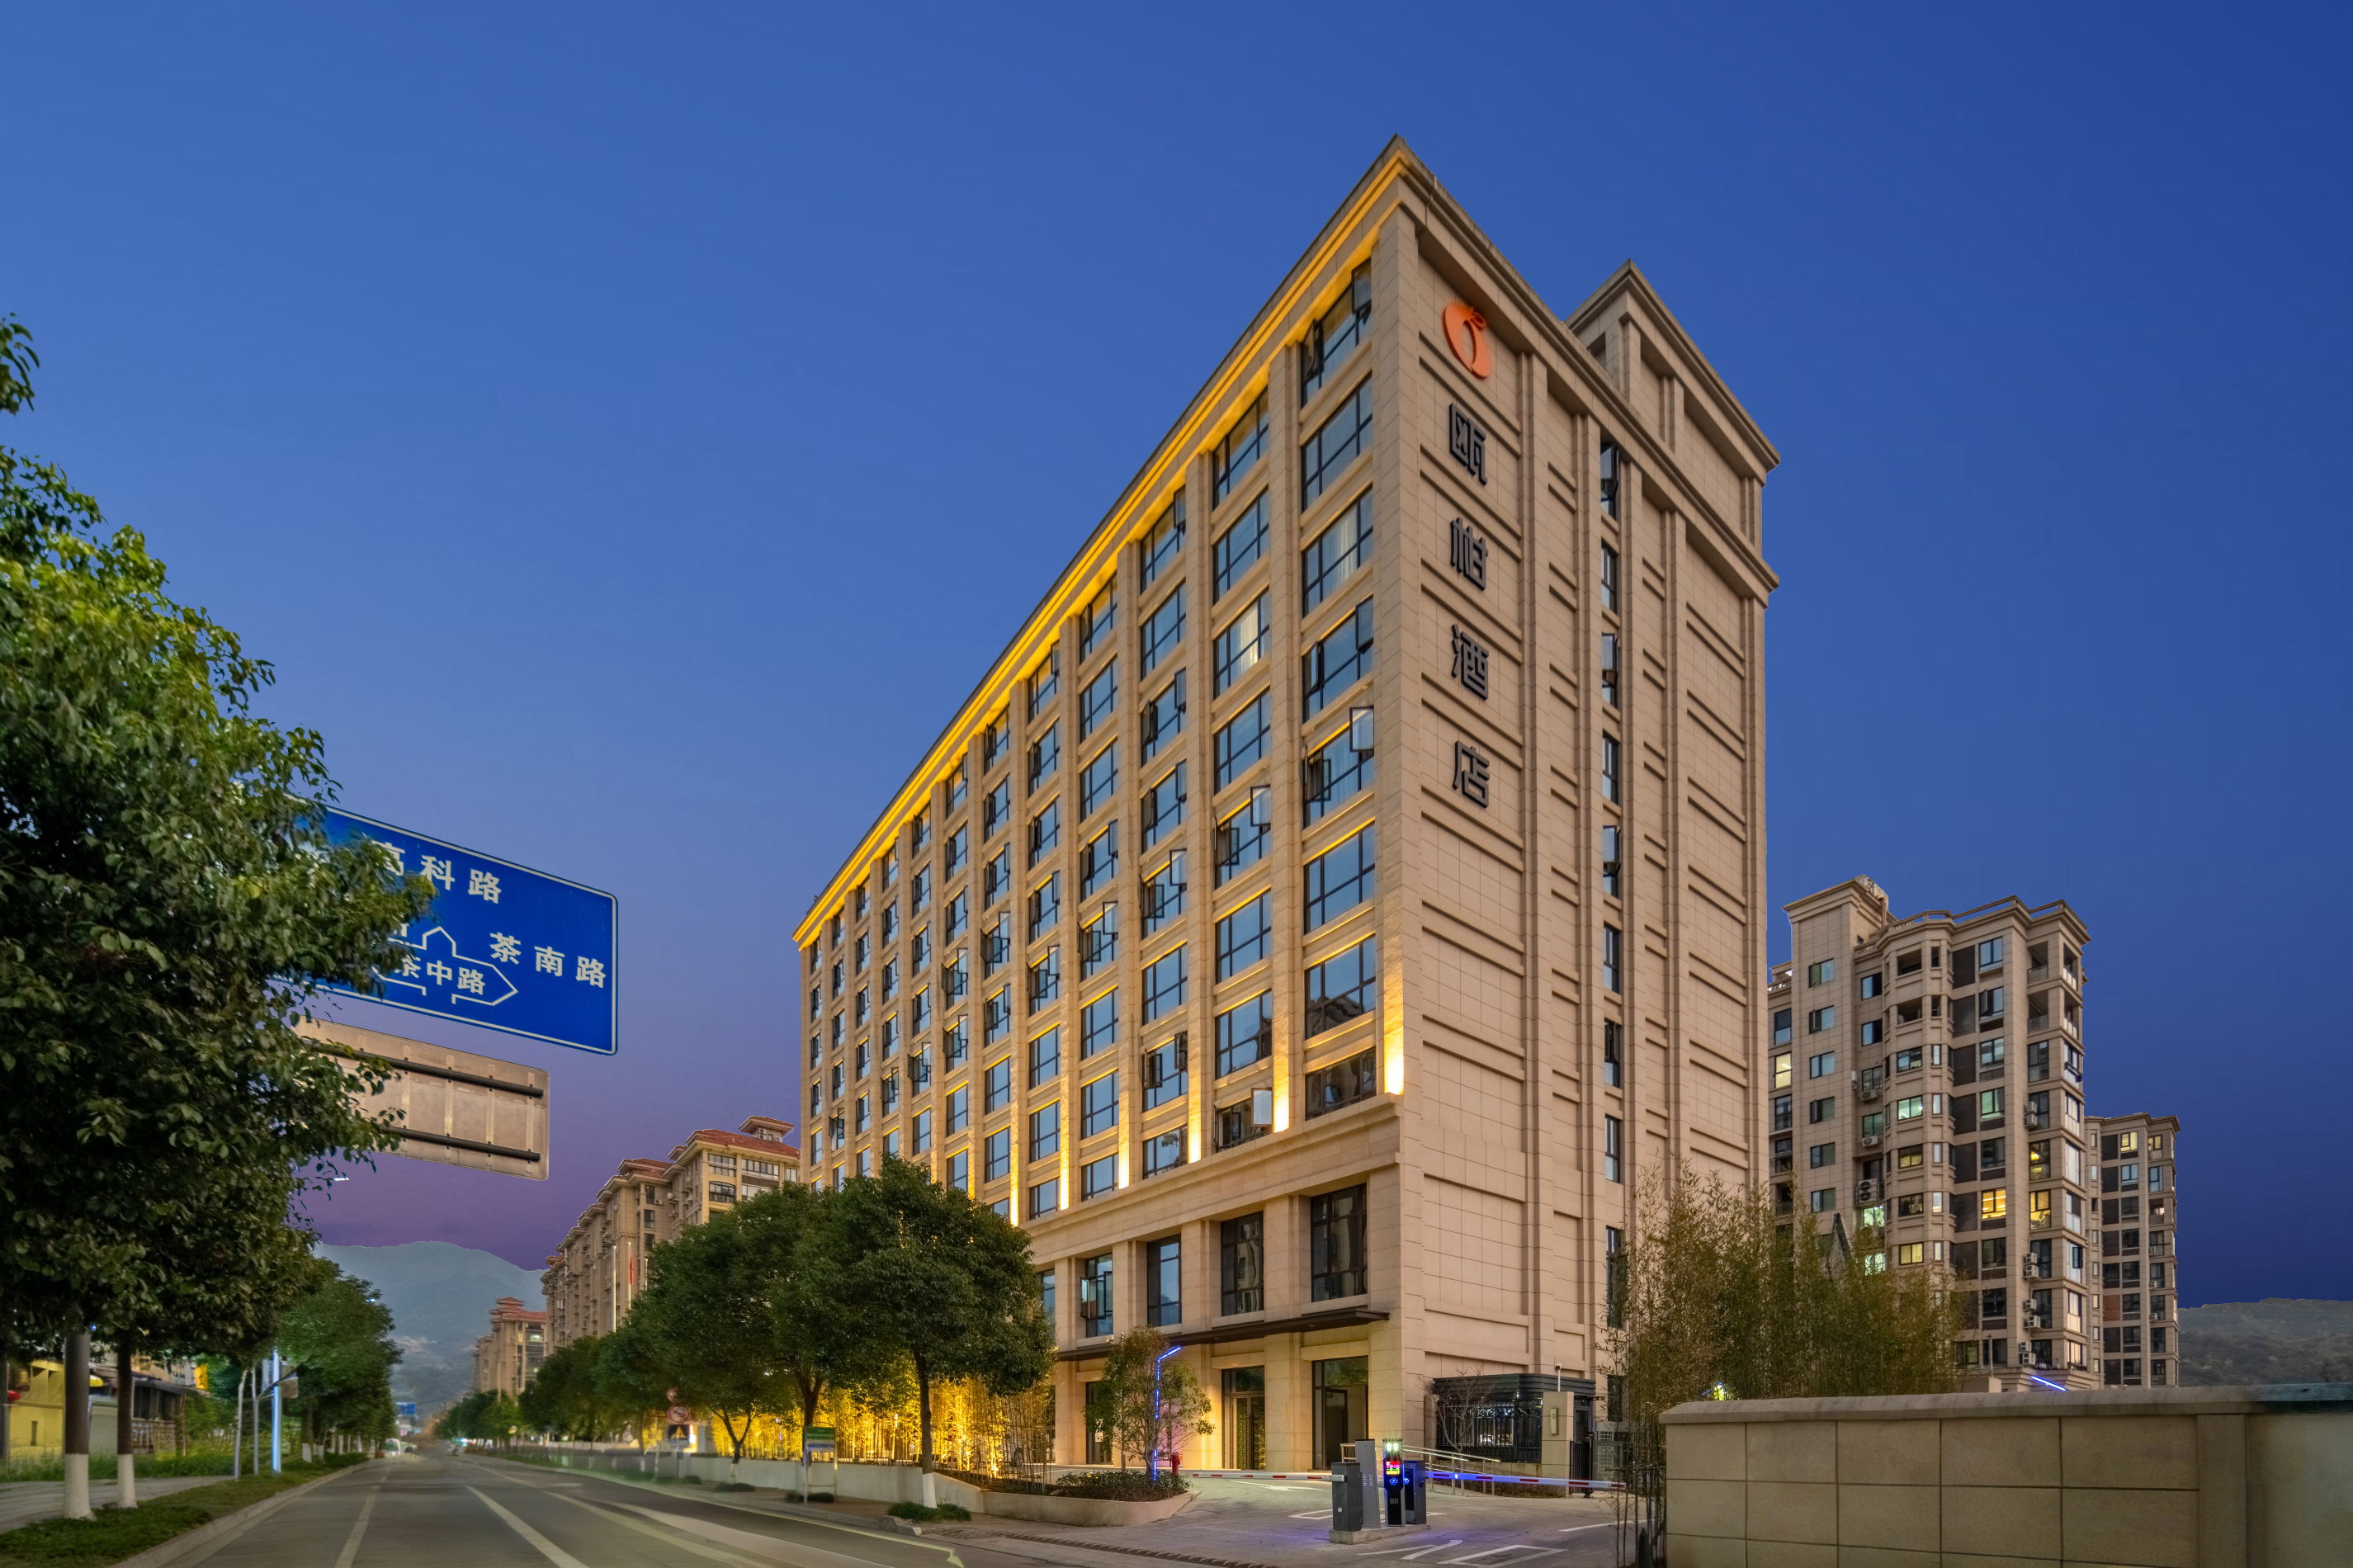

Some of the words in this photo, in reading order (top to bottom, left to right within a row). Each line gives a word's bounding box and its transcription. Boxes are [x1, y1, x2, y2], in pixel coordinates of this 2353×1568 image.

[1449, 403, 1489, 808] 瓯柑酒店
[490, 932, 607, 989] 茶南路
